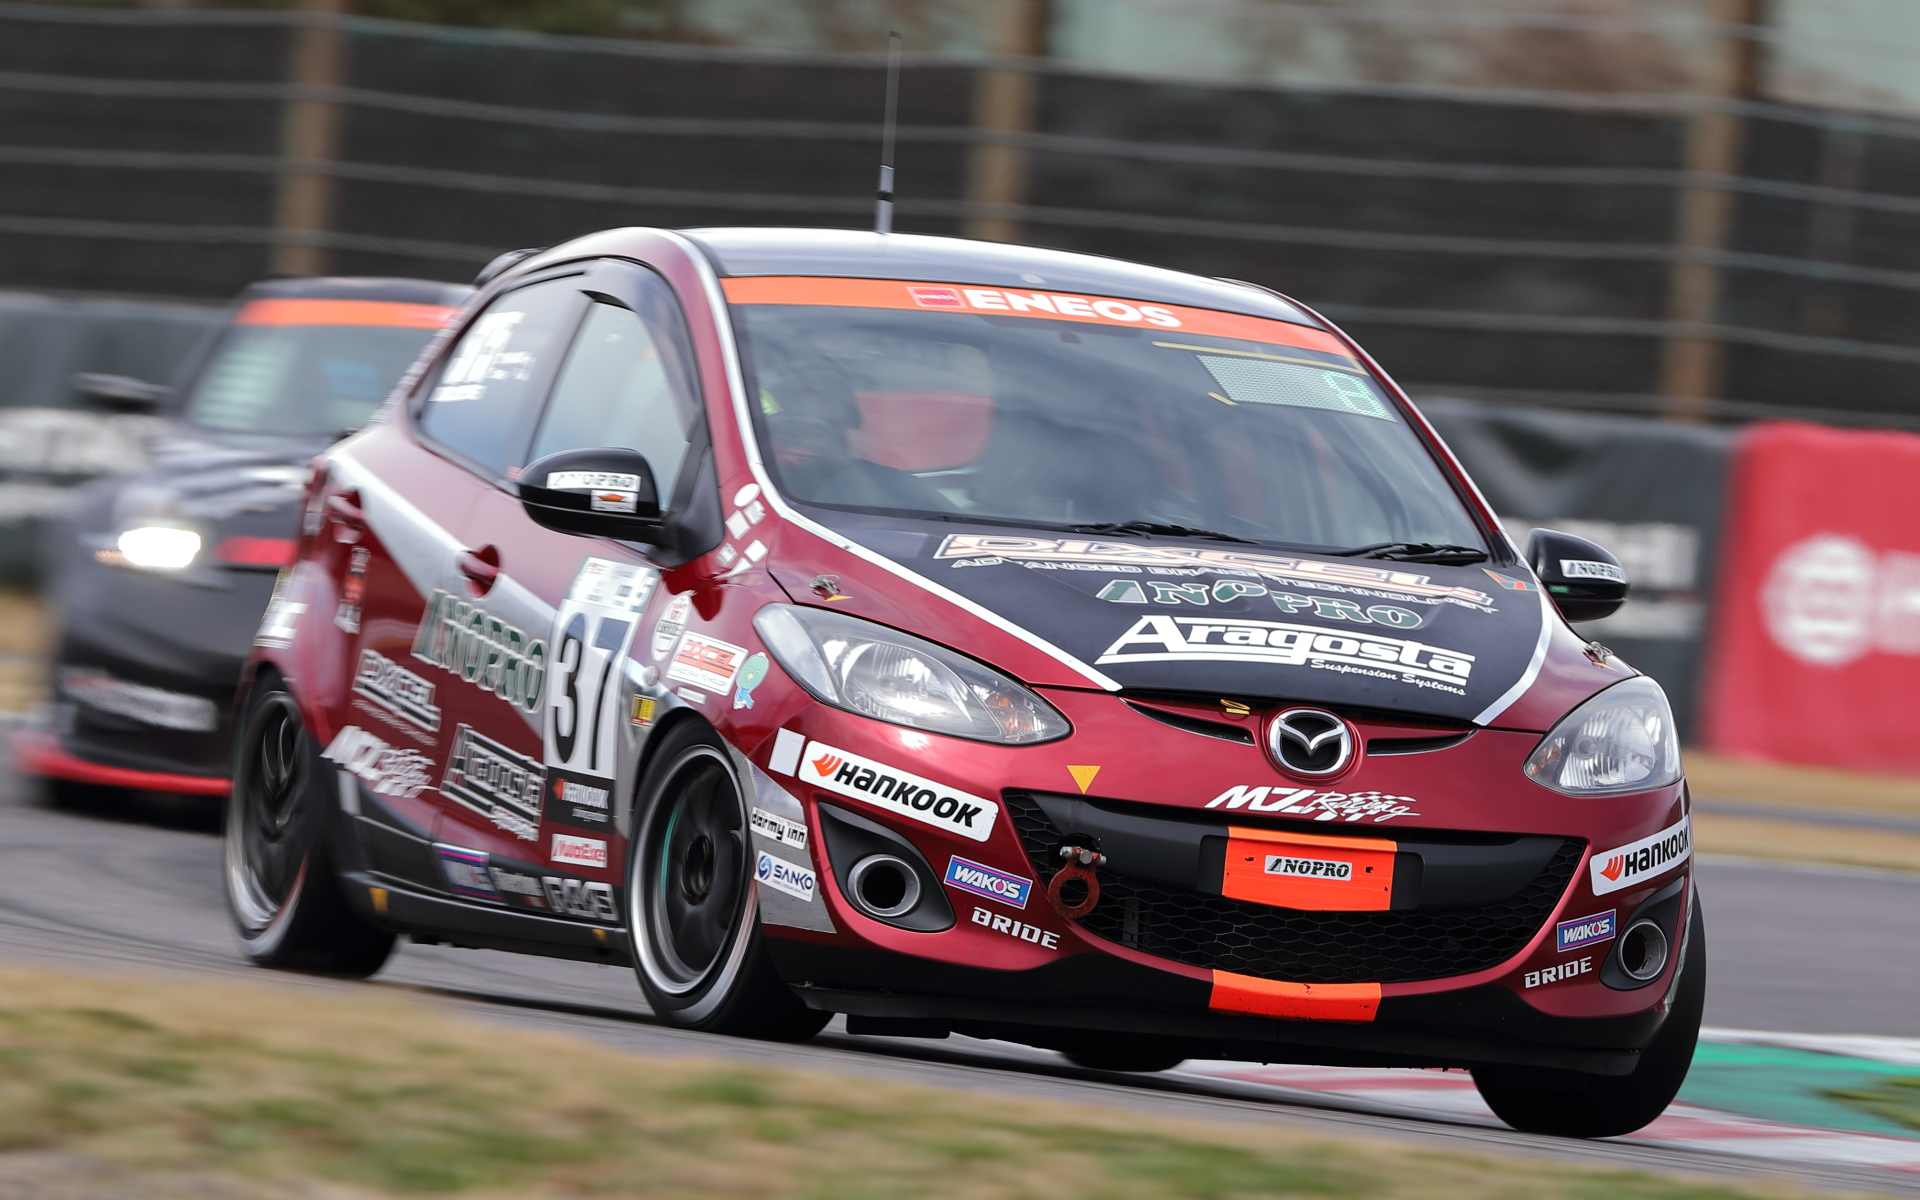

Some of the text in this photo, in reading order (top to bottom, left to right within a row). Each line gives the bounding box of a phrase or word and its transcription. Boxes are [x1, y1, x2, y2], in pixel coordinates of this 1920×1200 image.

[962, 288, 1182, 328] ENEOS
[933, 534, 1495, 608] DIXCEL
[1095, 614, 1476, 684] Aragosta
[553, 612, 633, 771] 37
[1310, 659, 1467, 696] Suspension Systems
[1204, 784, 1421, 822] MZ Racing
[773, 864, 814, 890] SANKO
[971, 906, 1061, 950] BRIDE
[1524, 956, 1593, 989] BRIDE
